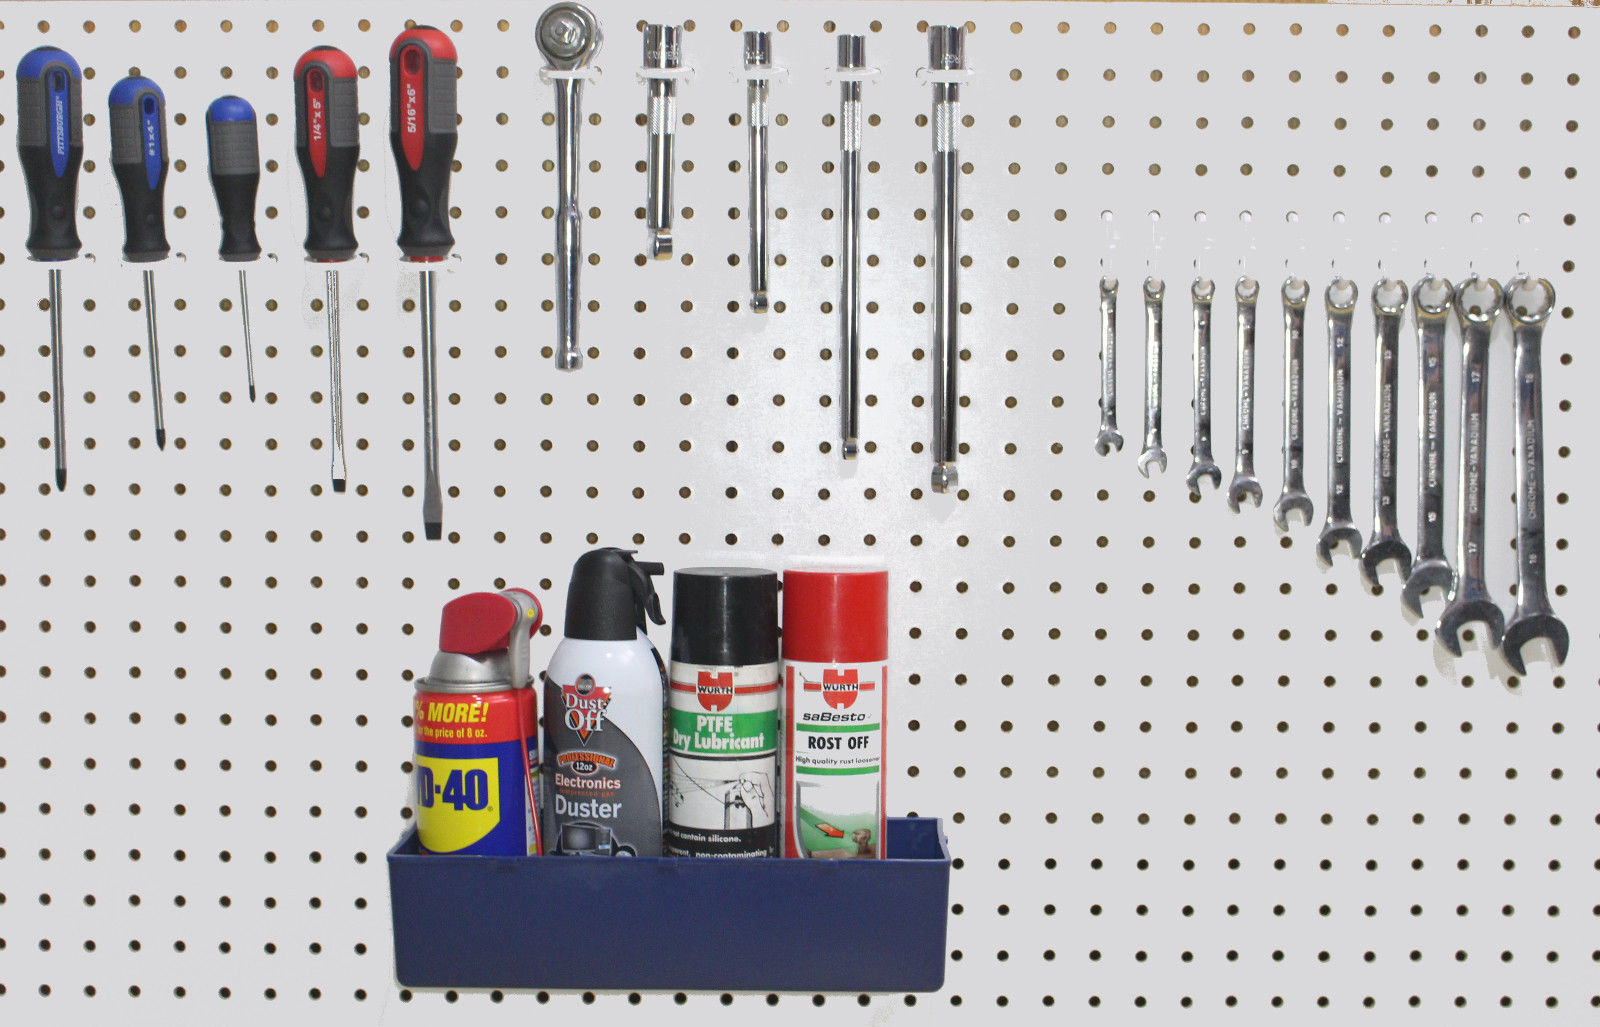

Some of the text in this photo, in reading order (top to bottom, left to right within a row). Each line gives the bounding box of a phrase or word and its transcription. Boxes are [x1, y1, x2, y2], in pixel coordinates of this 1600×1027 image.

[1471, 372, 1481, 383] 17
[1469, 413, 1480, 514] CHROME-VANADIUM
[1527, 419, 1537, 520] CHROME-VANADIUM
[1468, 542, 1477, 553] 17
[428, 702, 489, 723] MORE!
[565, 709, 607, 731] Off
[803, 712, 866, 721] saBesto
[697, 715, 733, 733] PTFE
[435, 728, 453, 738] price
[457, 728, 464, 738] of
[467, 727, 473, 738] 8
[673, 728, 765, 752] Dry Lubricant
[808, 736, 869, 750] ROST OFF
[576, 761, 594, 771] 12oz
[796, 756, 810, 765] High
[812, 757, 838, 765] quality
[555, 773, 621, 790] Electronics
[555, 794, 623, 819] Duster
[681, 833, 706, 842] contain
[708, 834, 742, 843] silicone.
